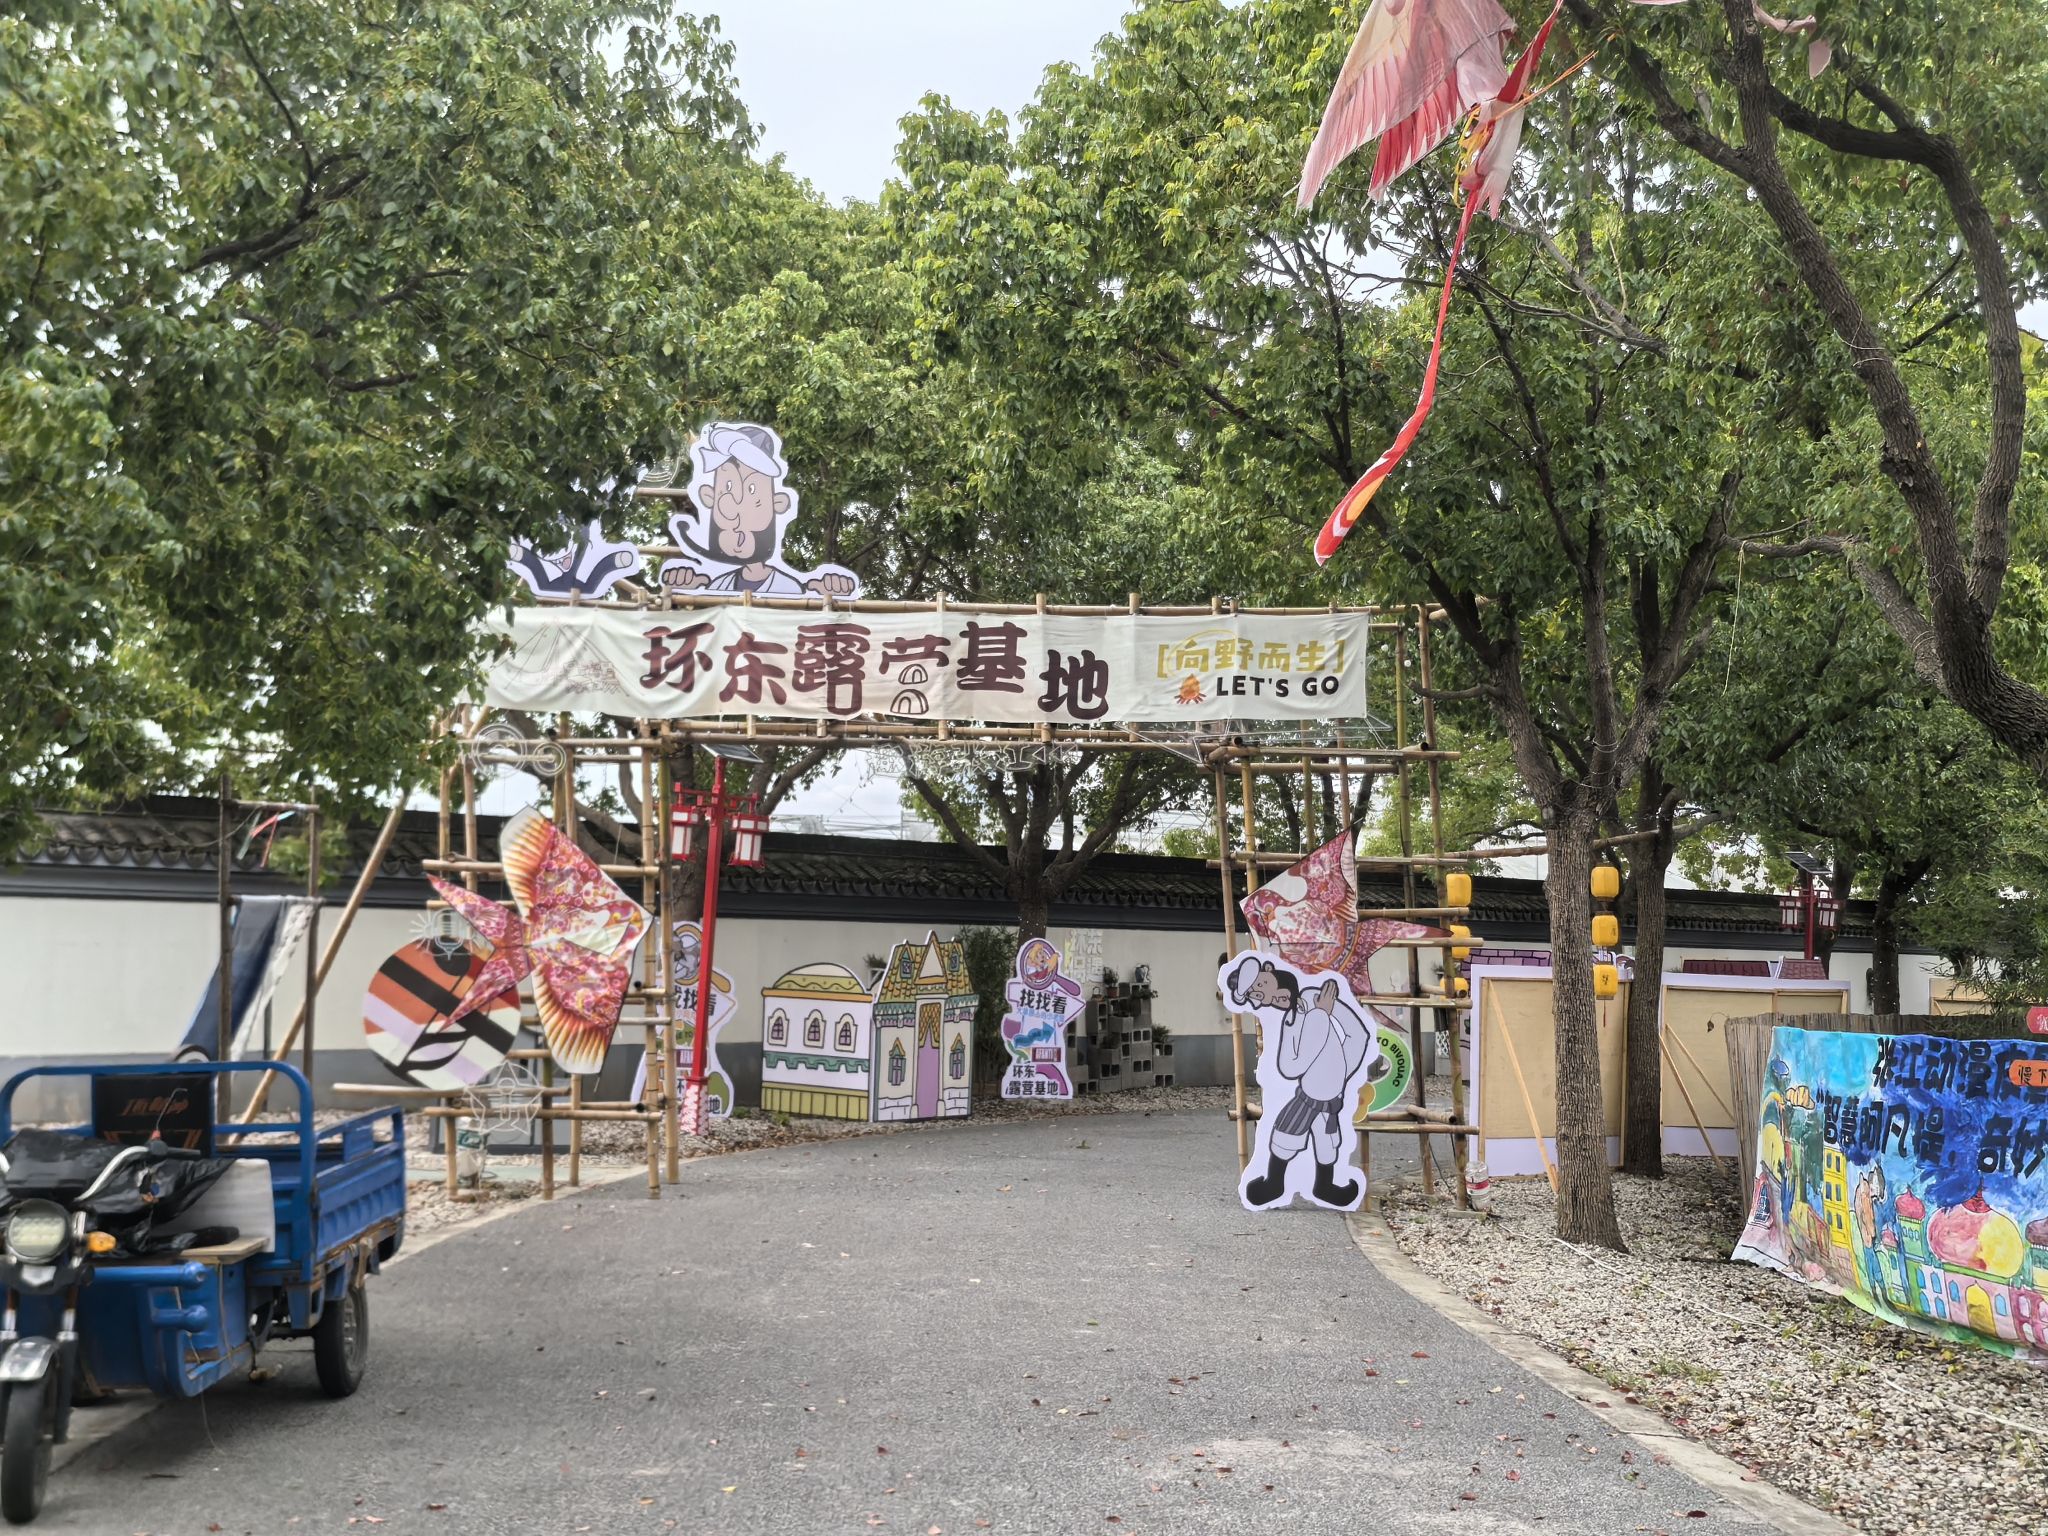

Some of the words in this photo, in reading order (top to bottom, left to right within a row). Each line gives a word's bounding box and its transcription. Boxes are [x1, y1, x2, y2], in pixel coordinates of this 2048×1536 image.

[640, 621, 1110, 720] 环东露营基地
[1216, 675, 1290, 698] LET'S
[1301, 676, 1340, 697] GO
[1020, 988, 1068, 1015] 找找看
[1012, 1061, 1036, 1078] 环东
[1389, 1043, 1406, 1088] BIVOUAC
[1008, 1080, 1059, 1096] 露营基地
